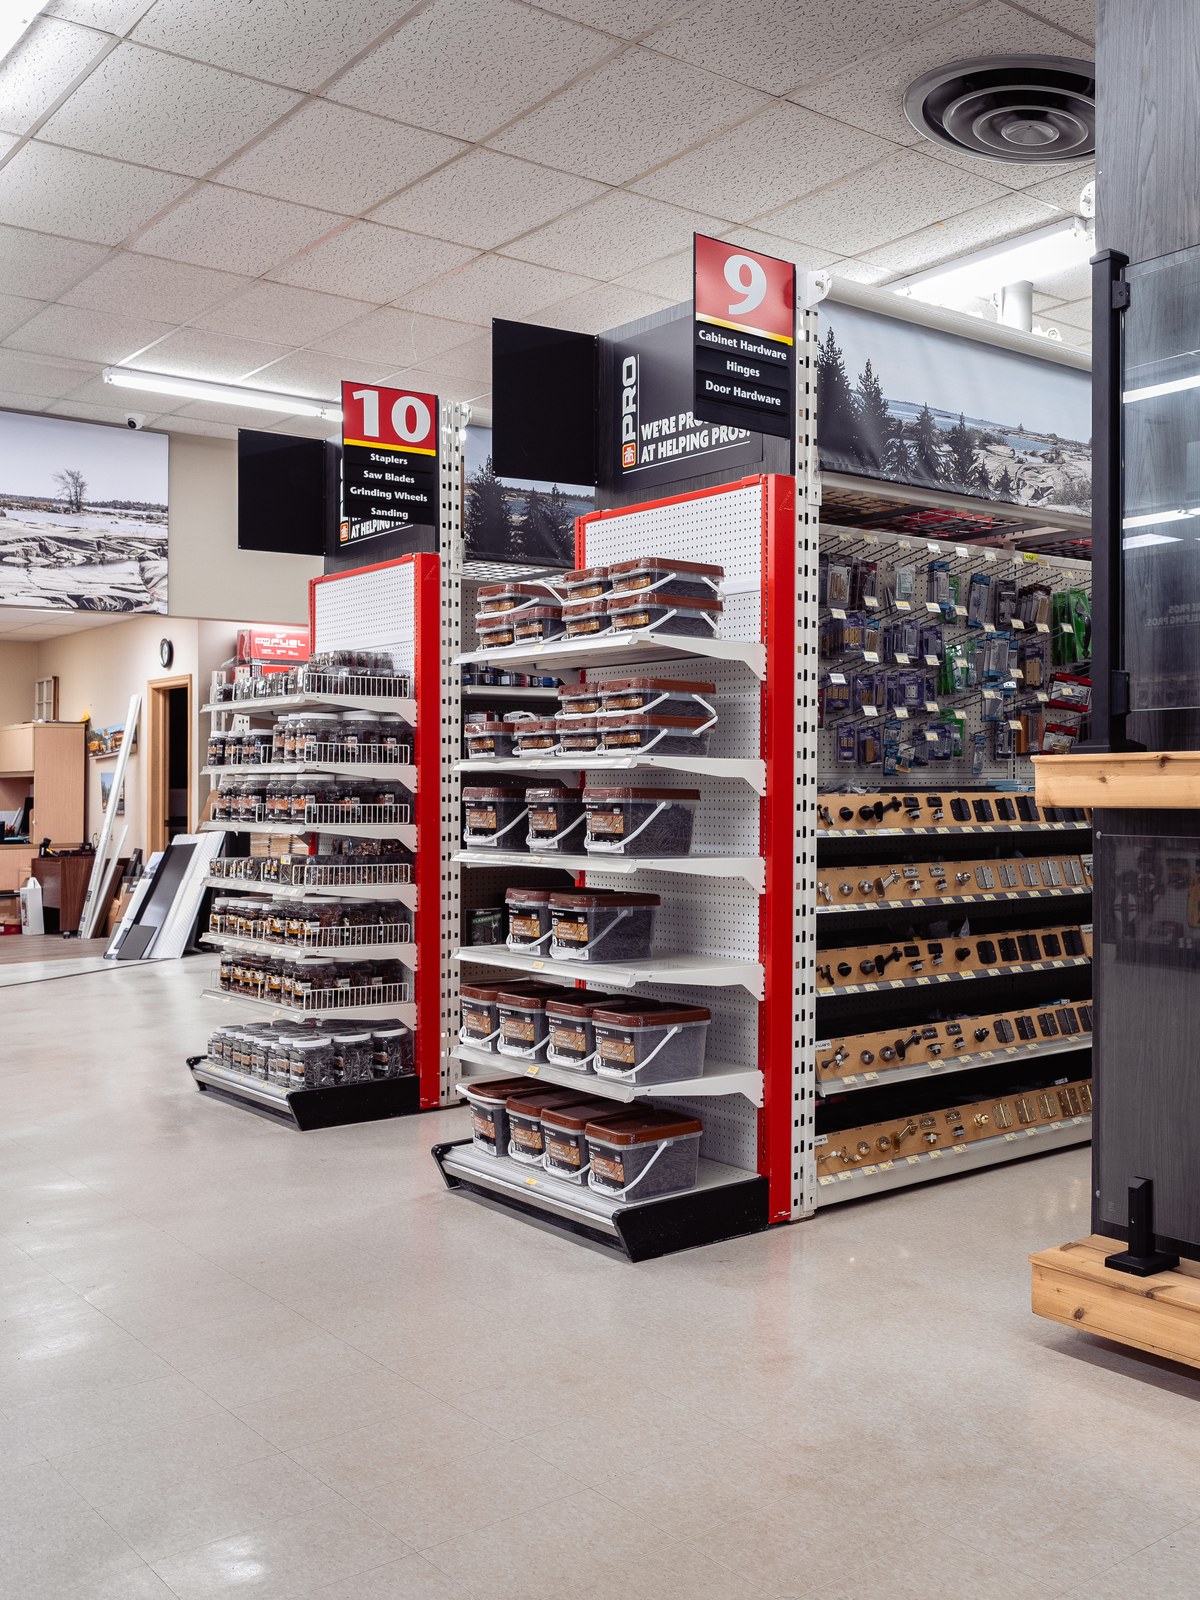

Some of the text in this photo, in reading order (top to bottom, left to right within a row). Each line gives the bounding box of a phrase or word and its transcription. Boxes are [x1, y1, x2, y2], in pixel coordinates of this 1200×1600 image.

[723, 254, 767, 315] 9
[698, 329, 787, 361] Cabinet Hardware
[726, 360, 760, 378] Hinges
[622, 355, 637, 443] PRO
[705, 380, 781, 406] Door Hardware
[352, 389, 431, 443] 10
[641, 415, 676, 441] WE'RE
[641, 445, 656, 464] AT
[657, 429, 709, 459] HELPING
[370, 453, 408, 465] Staplers
[363, 470, 415, 484] Saw Blades
[350, 486, 428, 502] Grinding Wheels
[370, 507, 409, 520] Sanding
[351, 524, 361, 540] AT
[271, 638, 306, 647] FUEL
